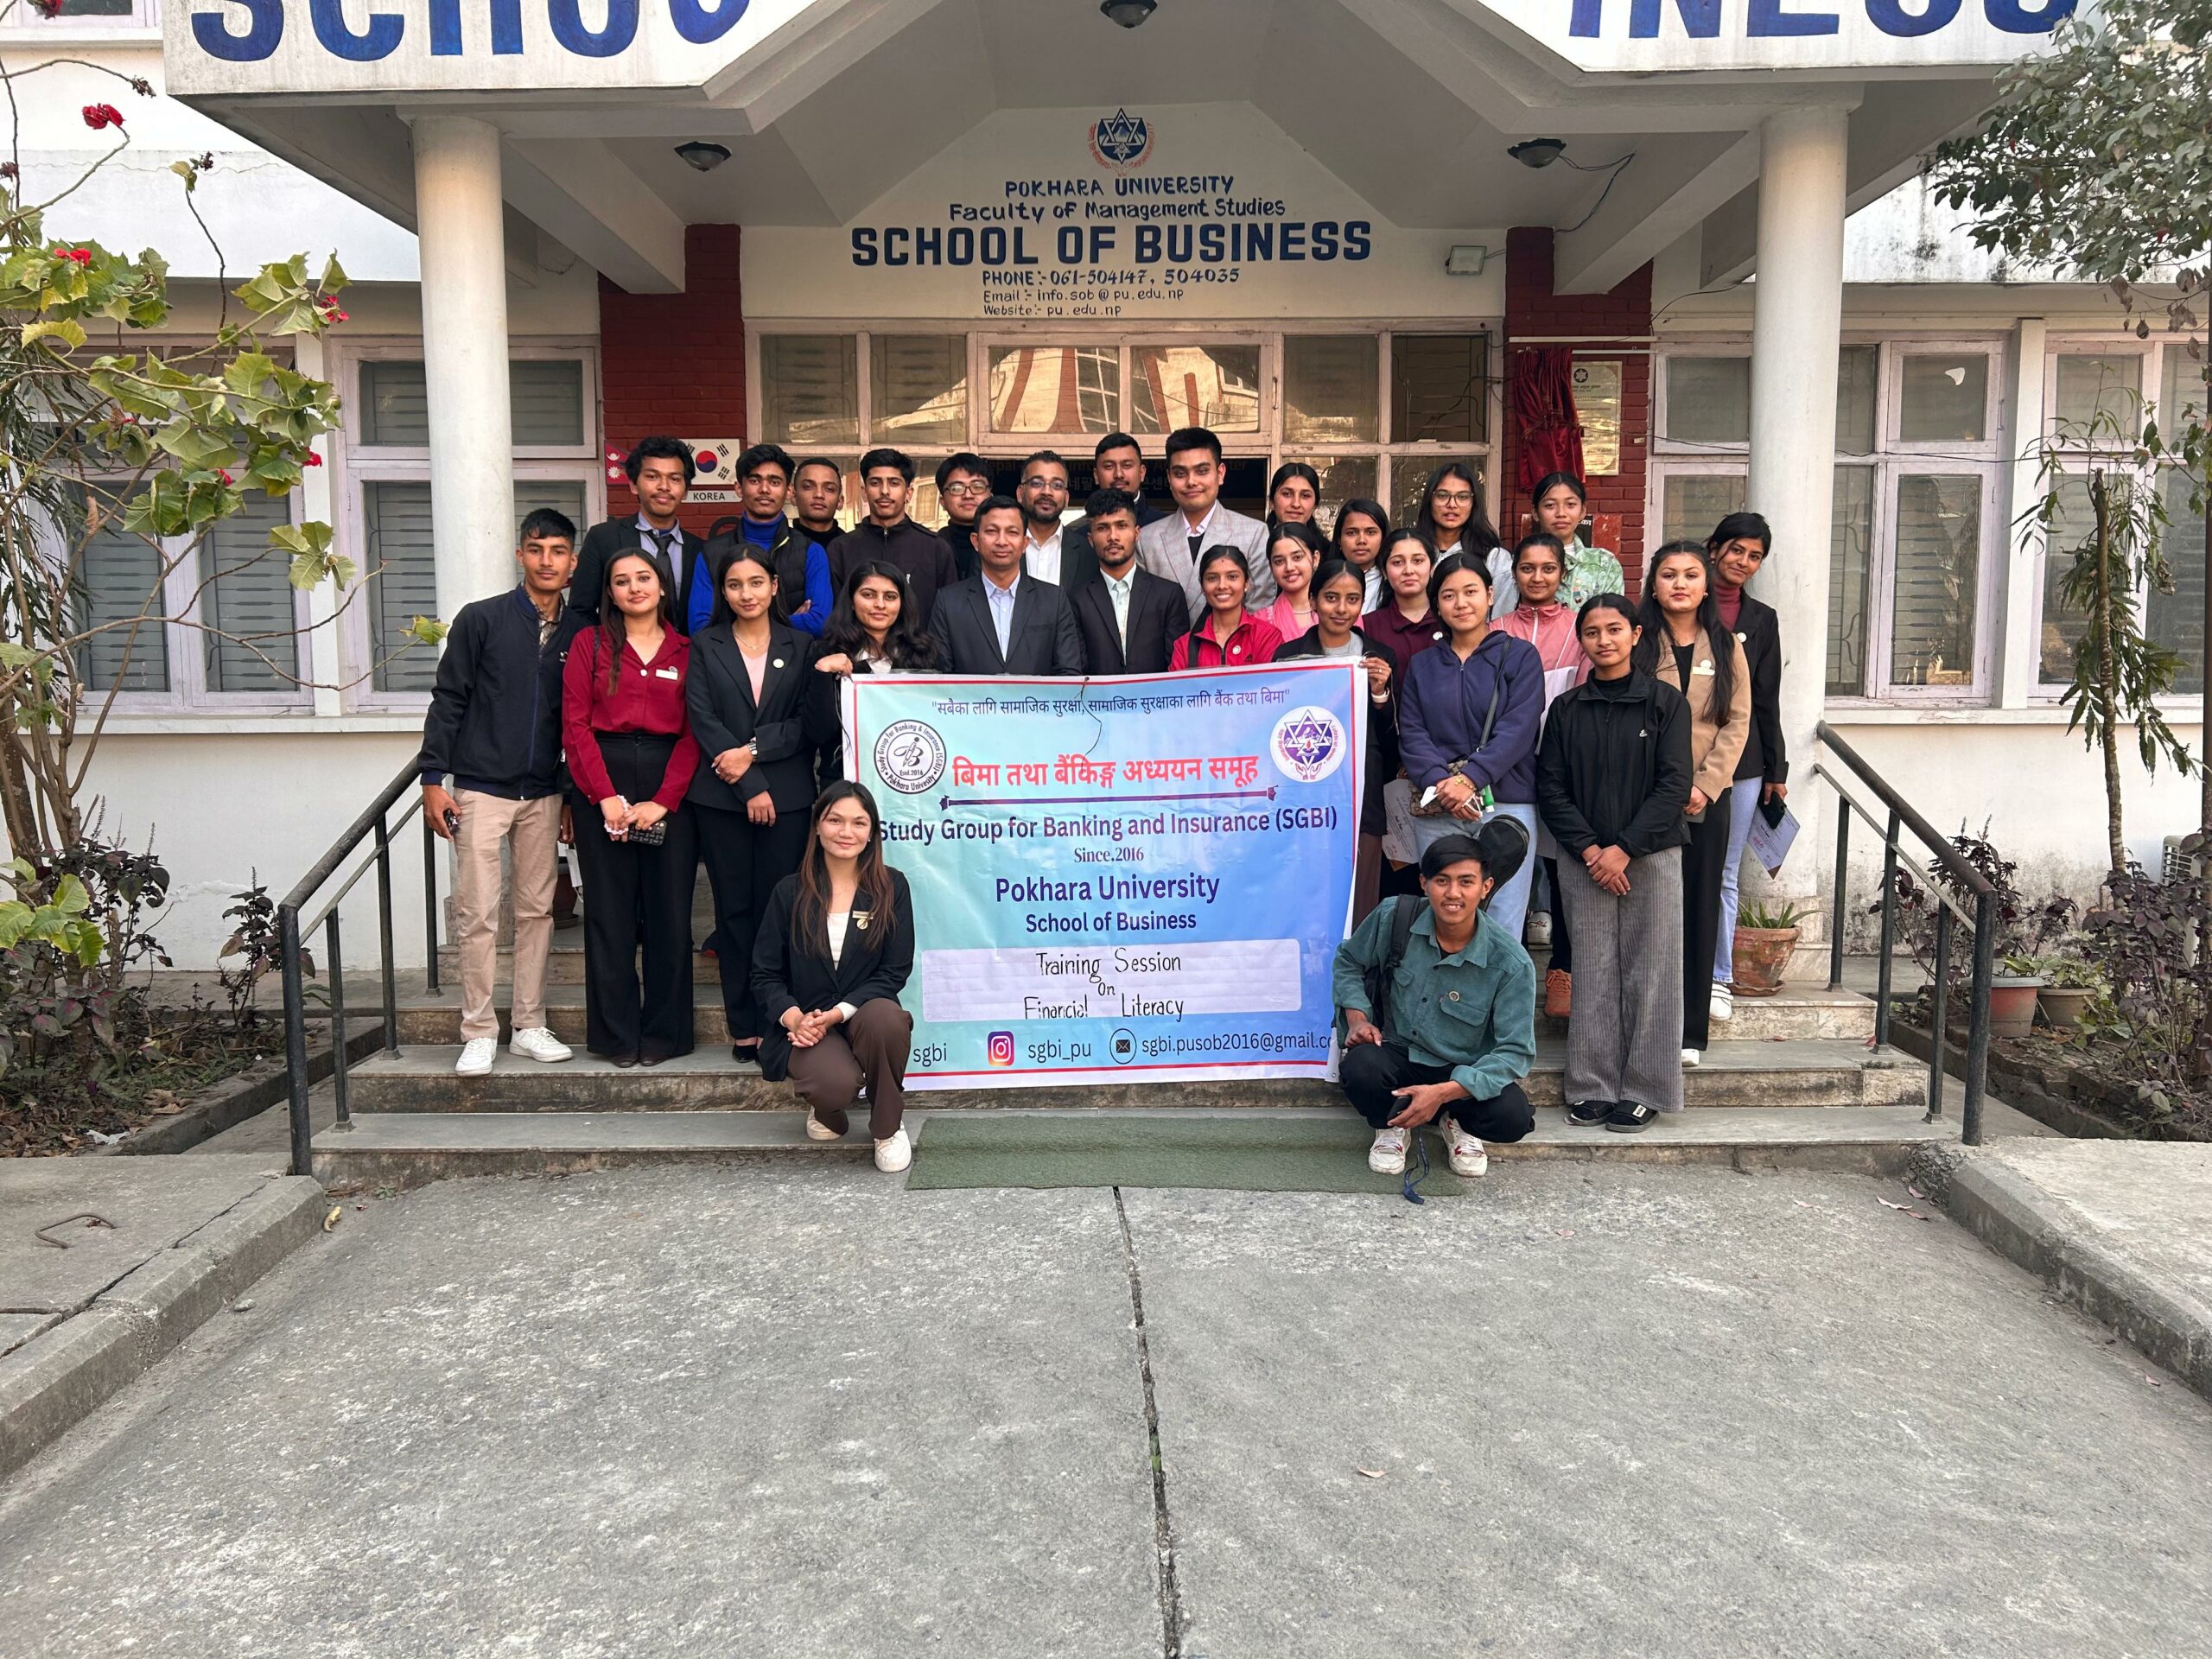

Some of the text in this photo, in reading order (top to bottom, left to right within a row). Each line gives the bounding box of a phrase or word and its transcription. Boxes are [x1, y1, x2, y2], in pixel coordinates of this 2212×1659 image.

[1006, 176, 1233, 198] POKHARA UNIVERSITY
[950, 203, 1045, 225] Faculty
[1085, 199, 1209, 220] Management
[1215, 198, 1285, 216] Studies
[852, 221, 1370, 266] SCHOOL OF BUSINESS
[1165, 269, 1239, 284] 504035
[972, 697, 997, 714] लागि
[1000, 696, 1049, 713] सामाजिक
[1088, 695, 1137, 711] सामाजिक
[1141, 696, 1183, 714] सुरक्षाका
[1186, 690, 1211, 707] लागि
[1214, 690, 1233, 705] बैंक
[1236, 693, 1257, 705] तथा
[894, 723, 917, 733] Banking
[877, 738, 889, 754] Group
[877, 757, 887, 772] Study
[951, 755, 1001, 788] बिमा
[1006, 762, 1048, 786] तथा
[1122, 758, 1202, 784] अध्ययन
[1208, 754, 1259, 788] समूह
[879, 806, 1337, 847] Study Group for Banking and Insurance (SGBI)
[1075, 848, 1143, 862] Since.2016
[996, 873, 1219, 904] Pokhara University
[1027, 911, 1196, 932] School of Business
[1036, 948, 1180, 984] Training Session
[1024, 993, 1183, 1022] Financial Literacy
[913, 1043, 946, 1067] sgbi
[1029, 1039, 1090, 1063] sgbi_pu
